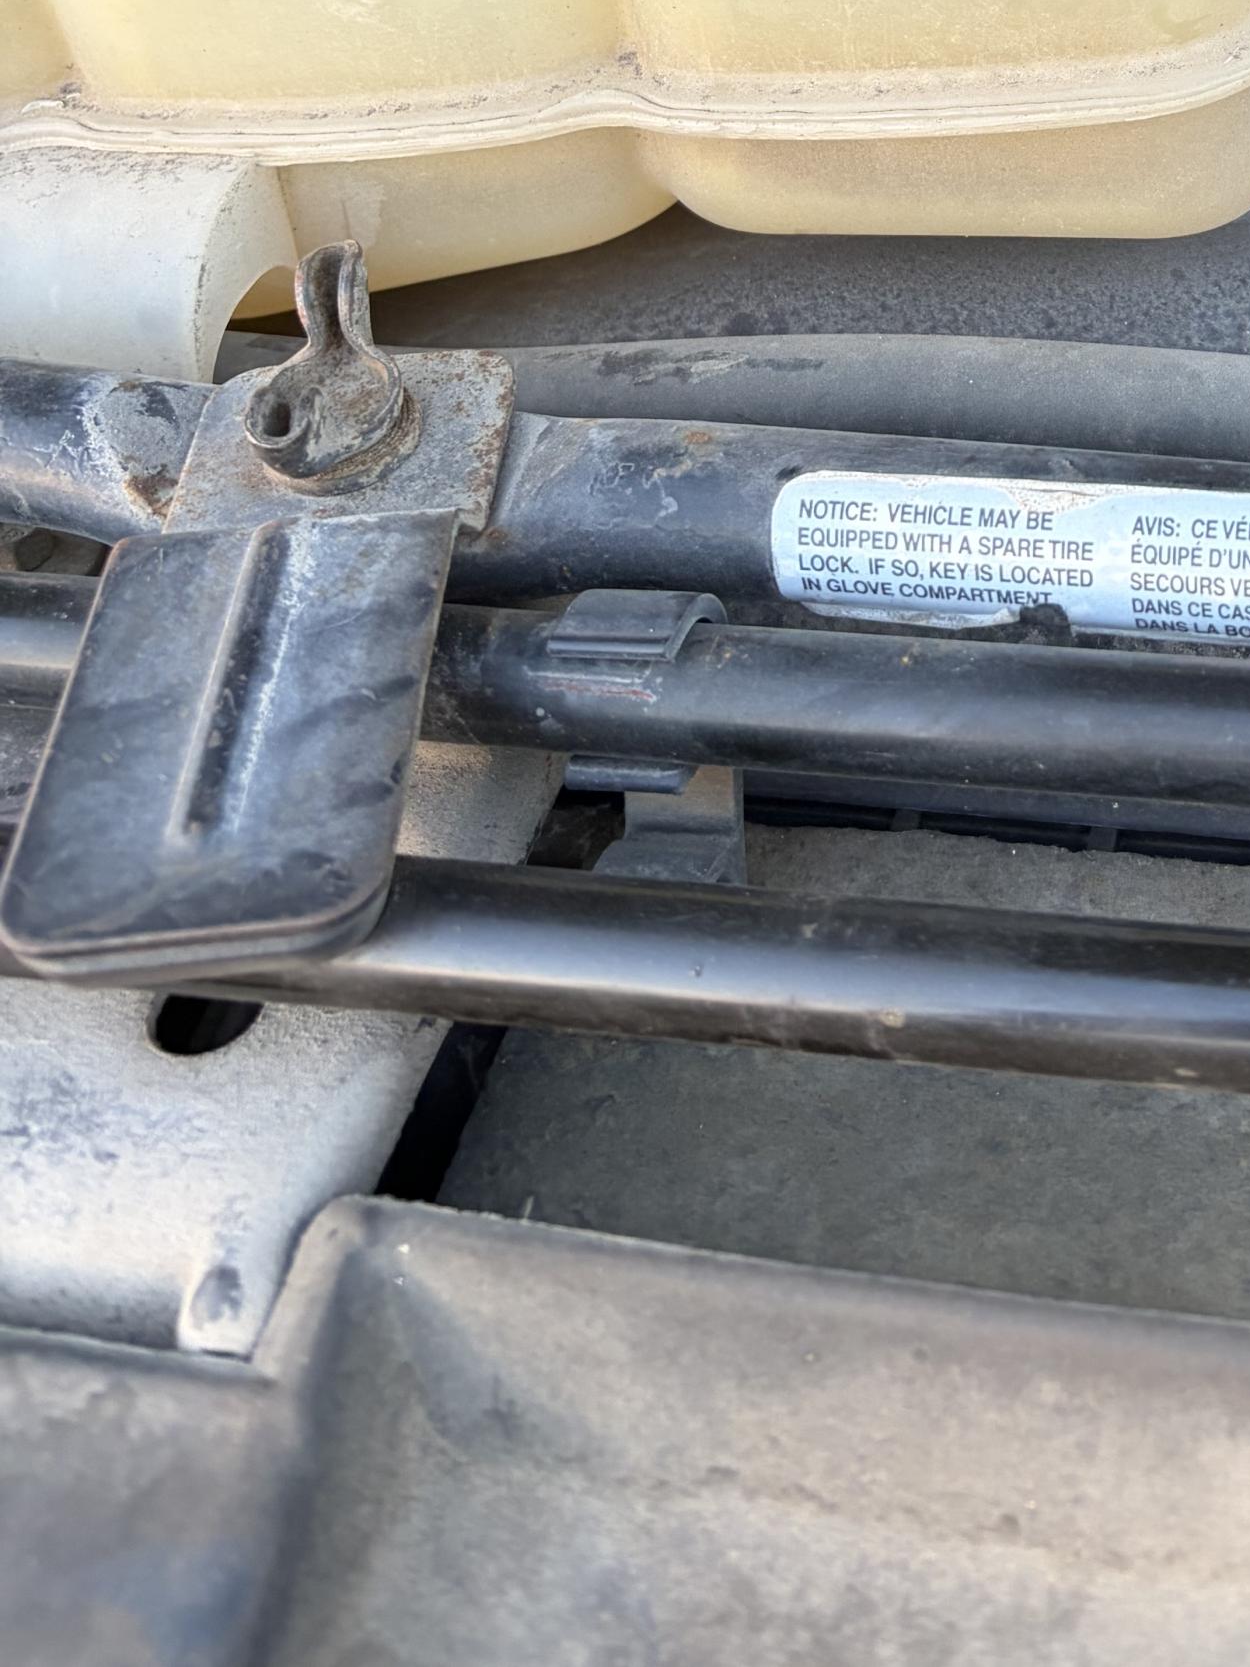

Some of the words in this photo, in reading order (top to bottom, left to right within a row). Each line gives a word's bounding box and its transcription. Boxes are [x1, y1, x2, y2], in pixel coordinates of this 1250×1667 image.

[799, 499, 878, 522] NOTICE:
[888, 503, 973, 527] VEHICLE
[978, 507, 1021, 530] MAY
[1026, 511, 1054, 531] BE
[1132, 515, 1181, 537] AVIS:
[1191, 519, 1218, 539] CE
[798, 527, 898, 551] EQUIPPED
[903, 532, 952, 554] WITH
[958, 535, 973, 555] A
[978, 536, 1045, 559] SPARE
[1049, 540, 1094, 561] TIRE
[1130, 537, 1203, 567] ÉQUIPÉ
[799, 554, 859, 575] LOCK.
[869, 557, 885, 575] IF
[891, 559, 924, 580] SO,
[929, 561, 970, 581] KEY
[975, 564, 993, 582] IS
[999, 566, 1094, 588] LOCATED
[1130, 572, 1225, 596] SECOURS
[801, 577, 822, 592] IN
[826, 578, 895, 597] GLOVE
[899, 583, 1053, 605] COMPARTMENT
[1131, 597, 1182, 617] DANS
[1187, 601, 1212, 618] CE
[1134, 618, 1189, 633] DANS
[1193, 622, 1219, 636] LA
